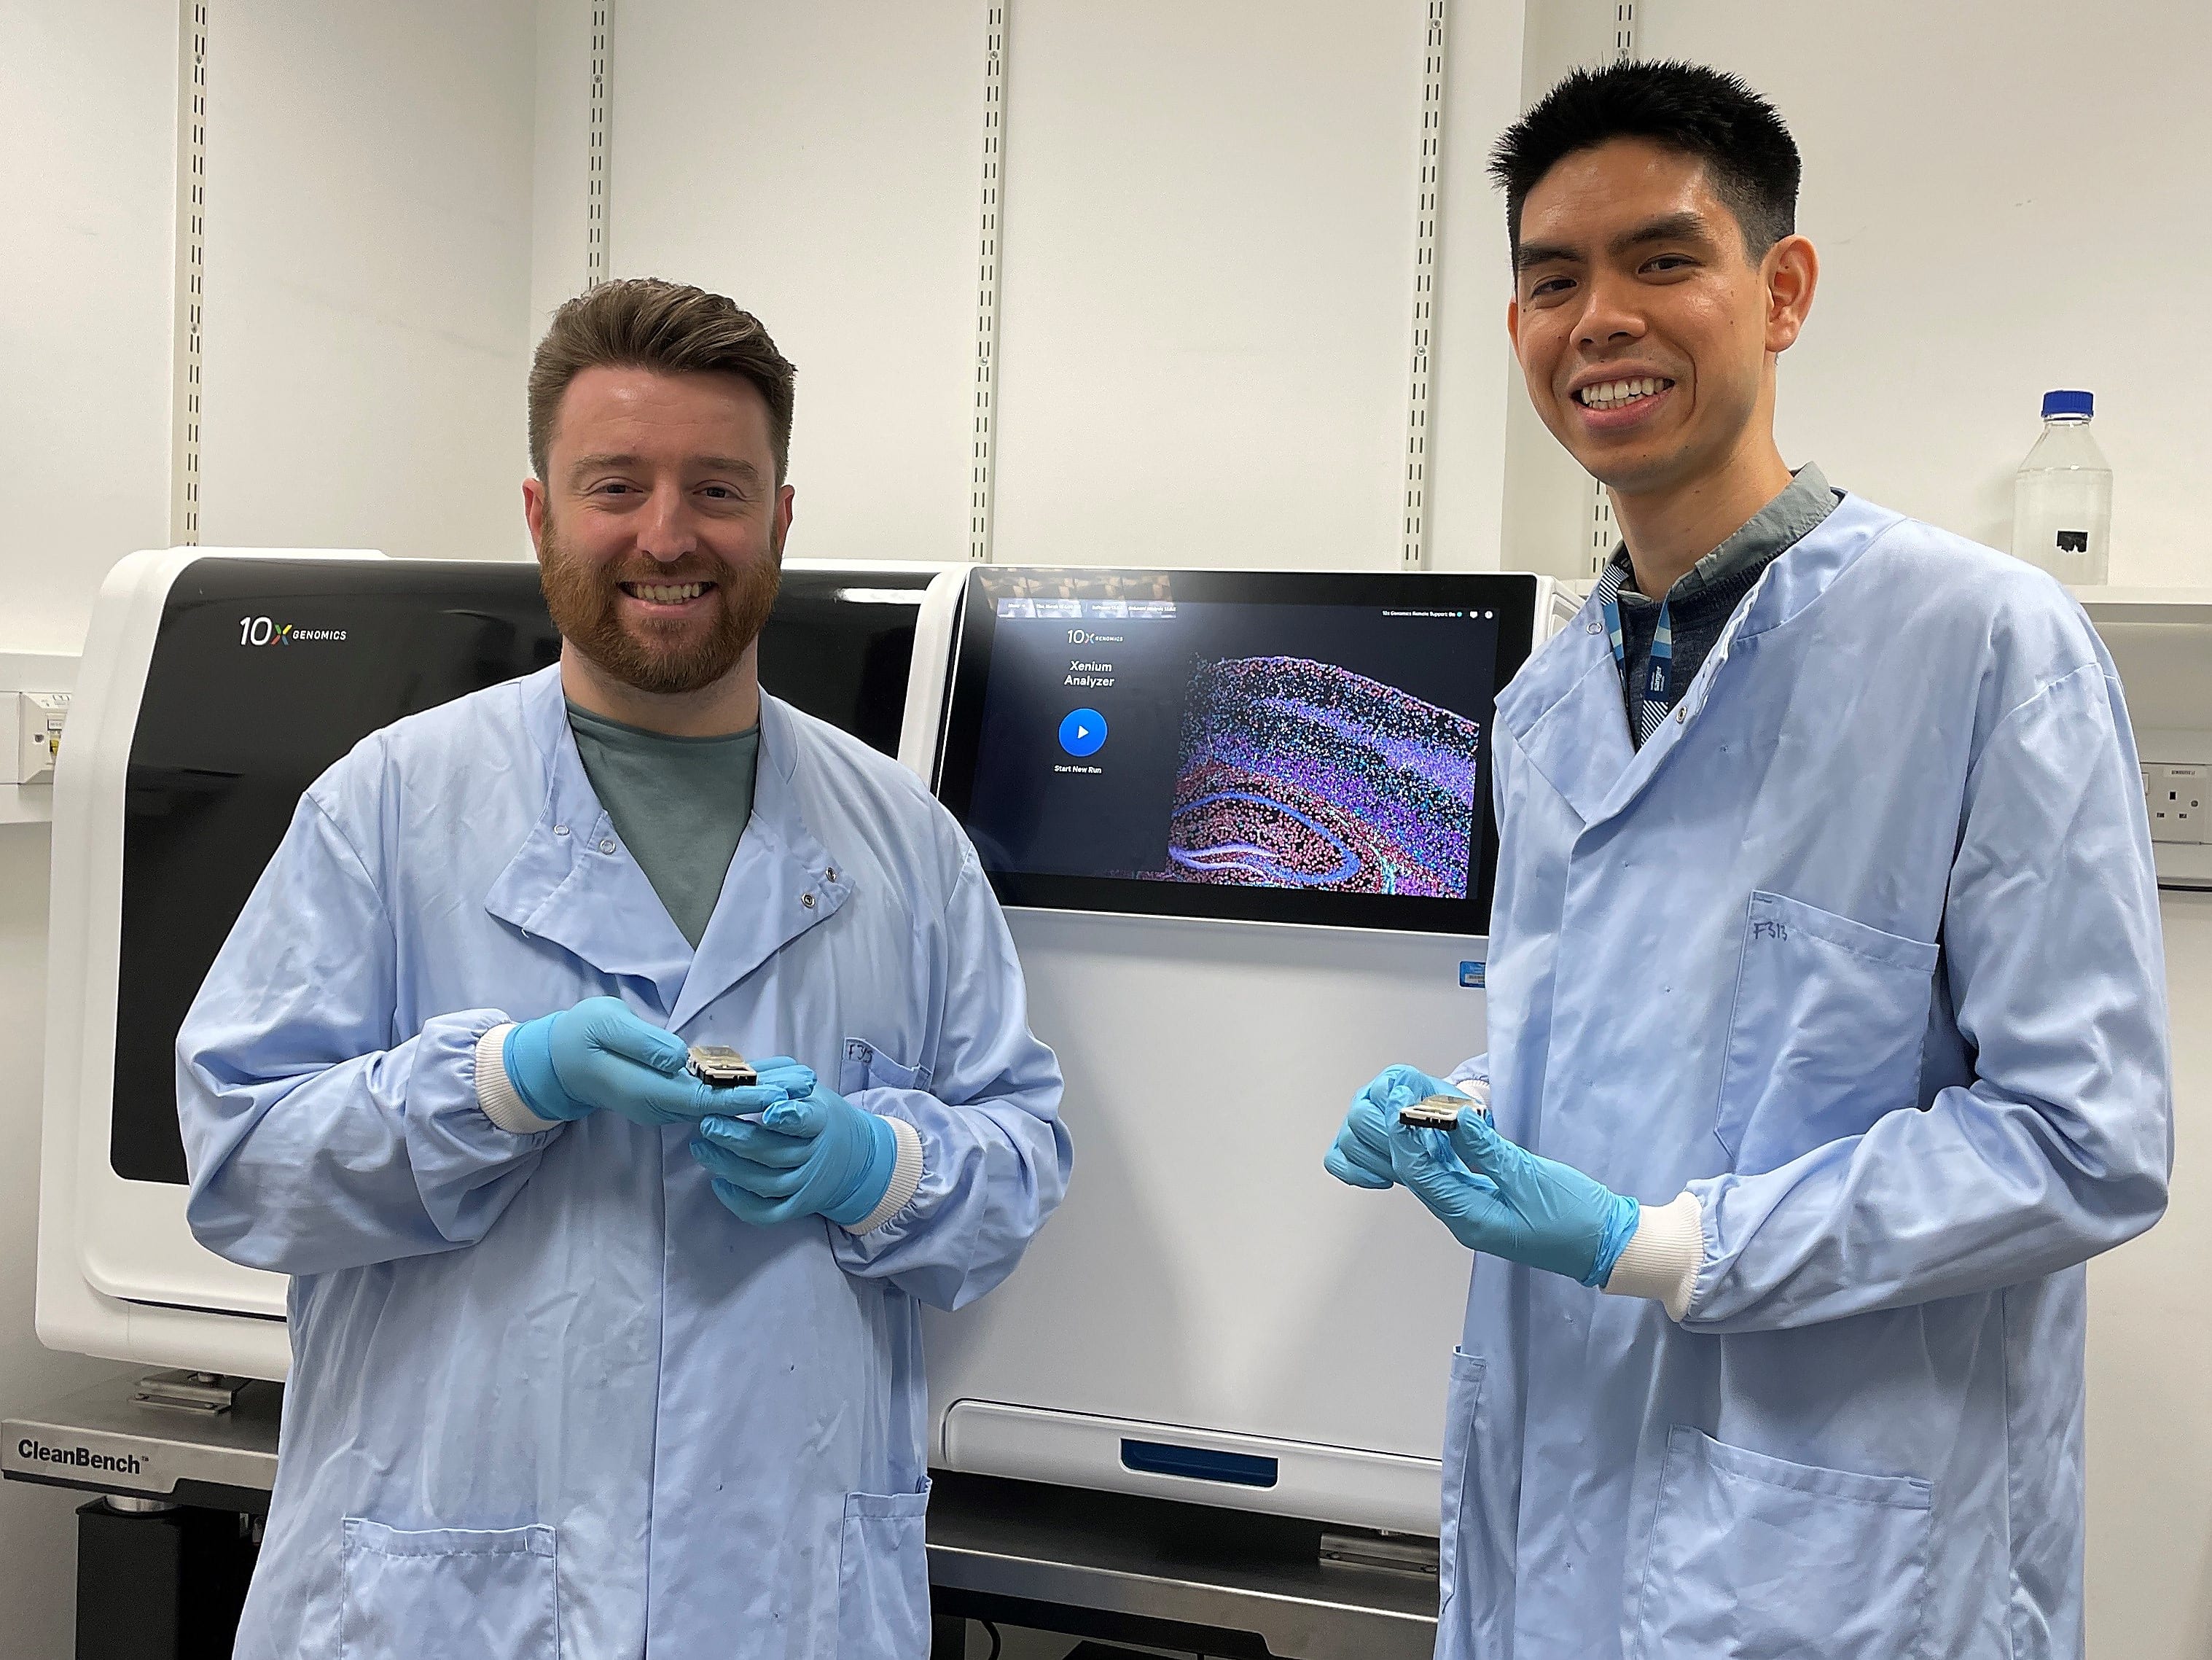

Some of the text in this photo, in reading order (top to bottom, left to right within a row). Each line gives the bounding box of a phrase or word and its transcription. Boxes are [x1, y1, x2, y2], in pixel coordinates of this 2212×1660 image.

[292, 630, 347, 641] GENOMICS
[1069, 661, 1112, 672] Xenium
[1063, 674, 1115, 688] Analyzer
